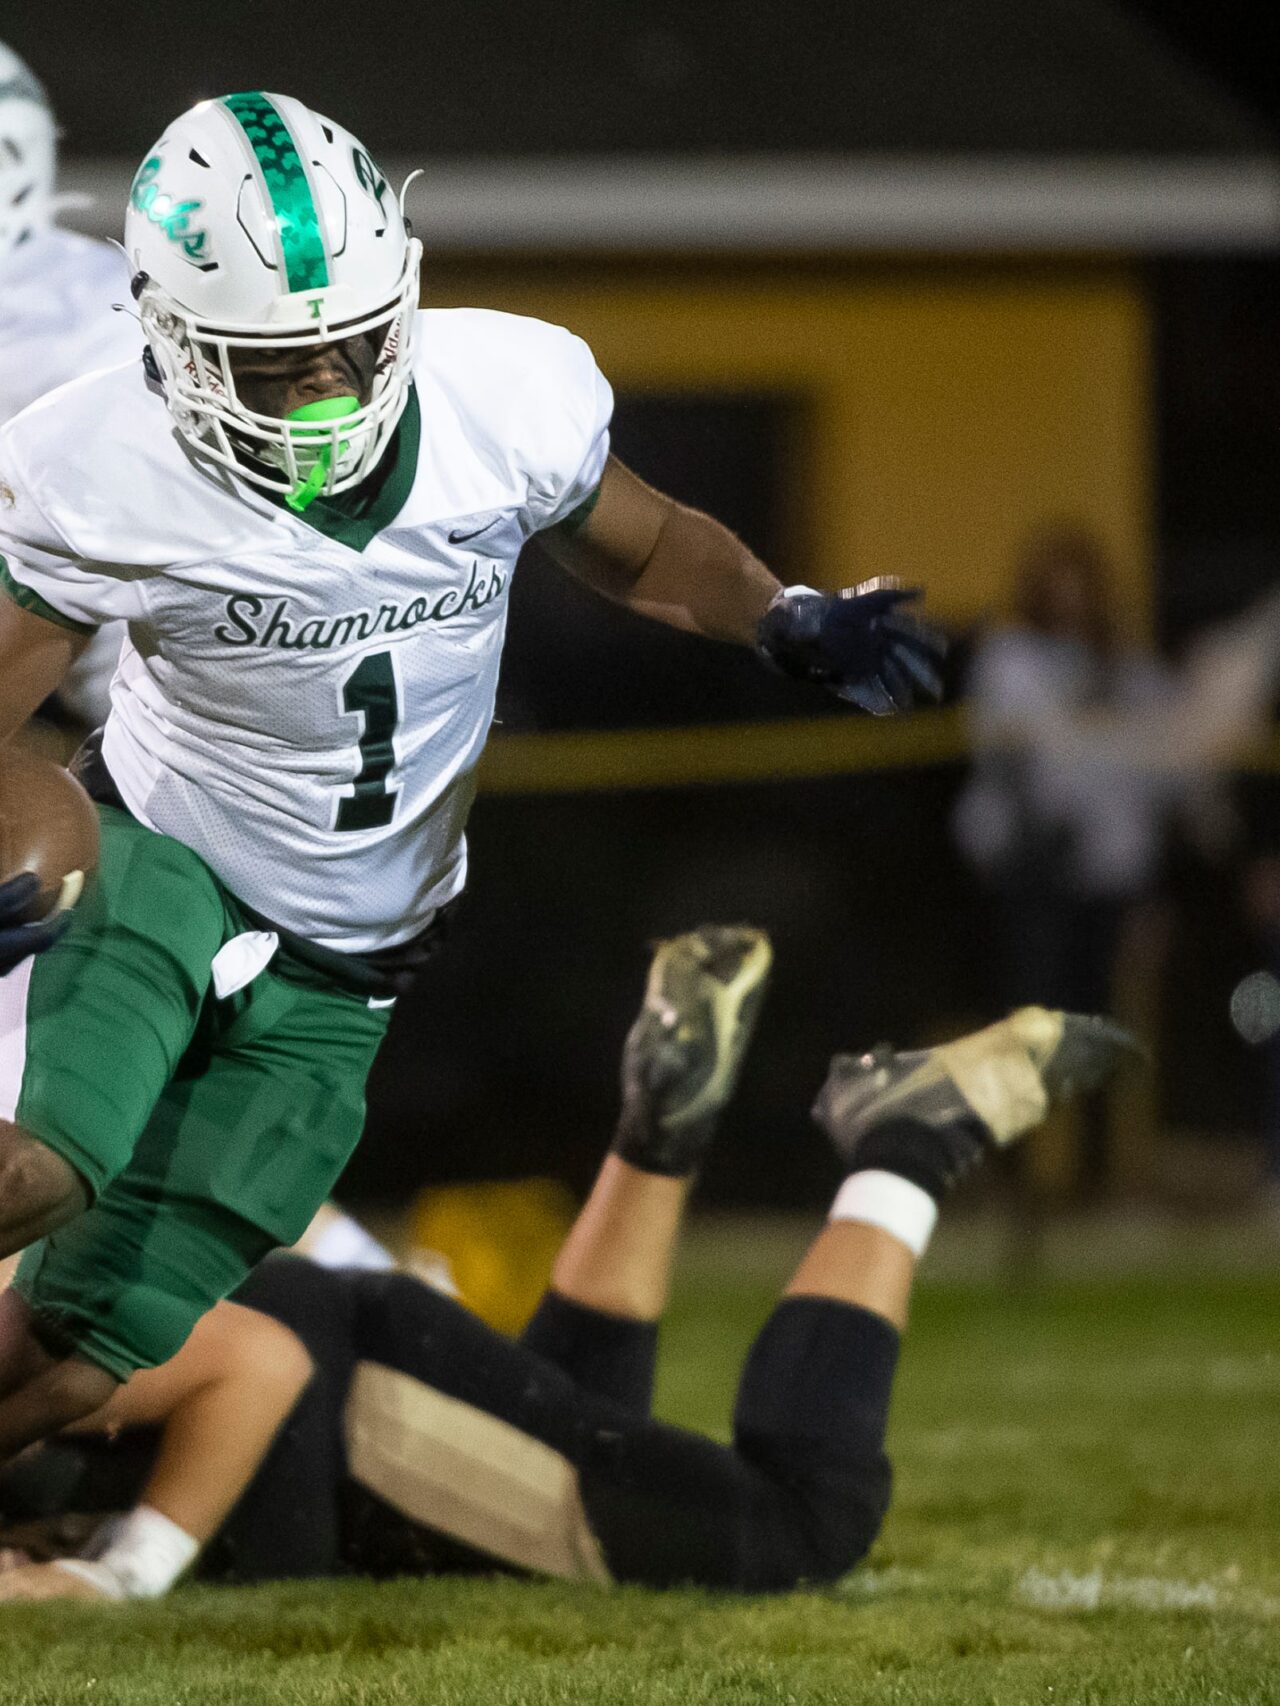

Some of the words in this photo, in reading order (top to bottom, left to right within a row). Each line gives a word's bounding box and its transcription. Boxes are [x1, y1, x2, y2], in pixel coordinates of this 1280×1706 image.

[306, 298, 324, 319] T
[214, 560, 507, 650] Shamrocks
[332, 648, 400, 833] 1
